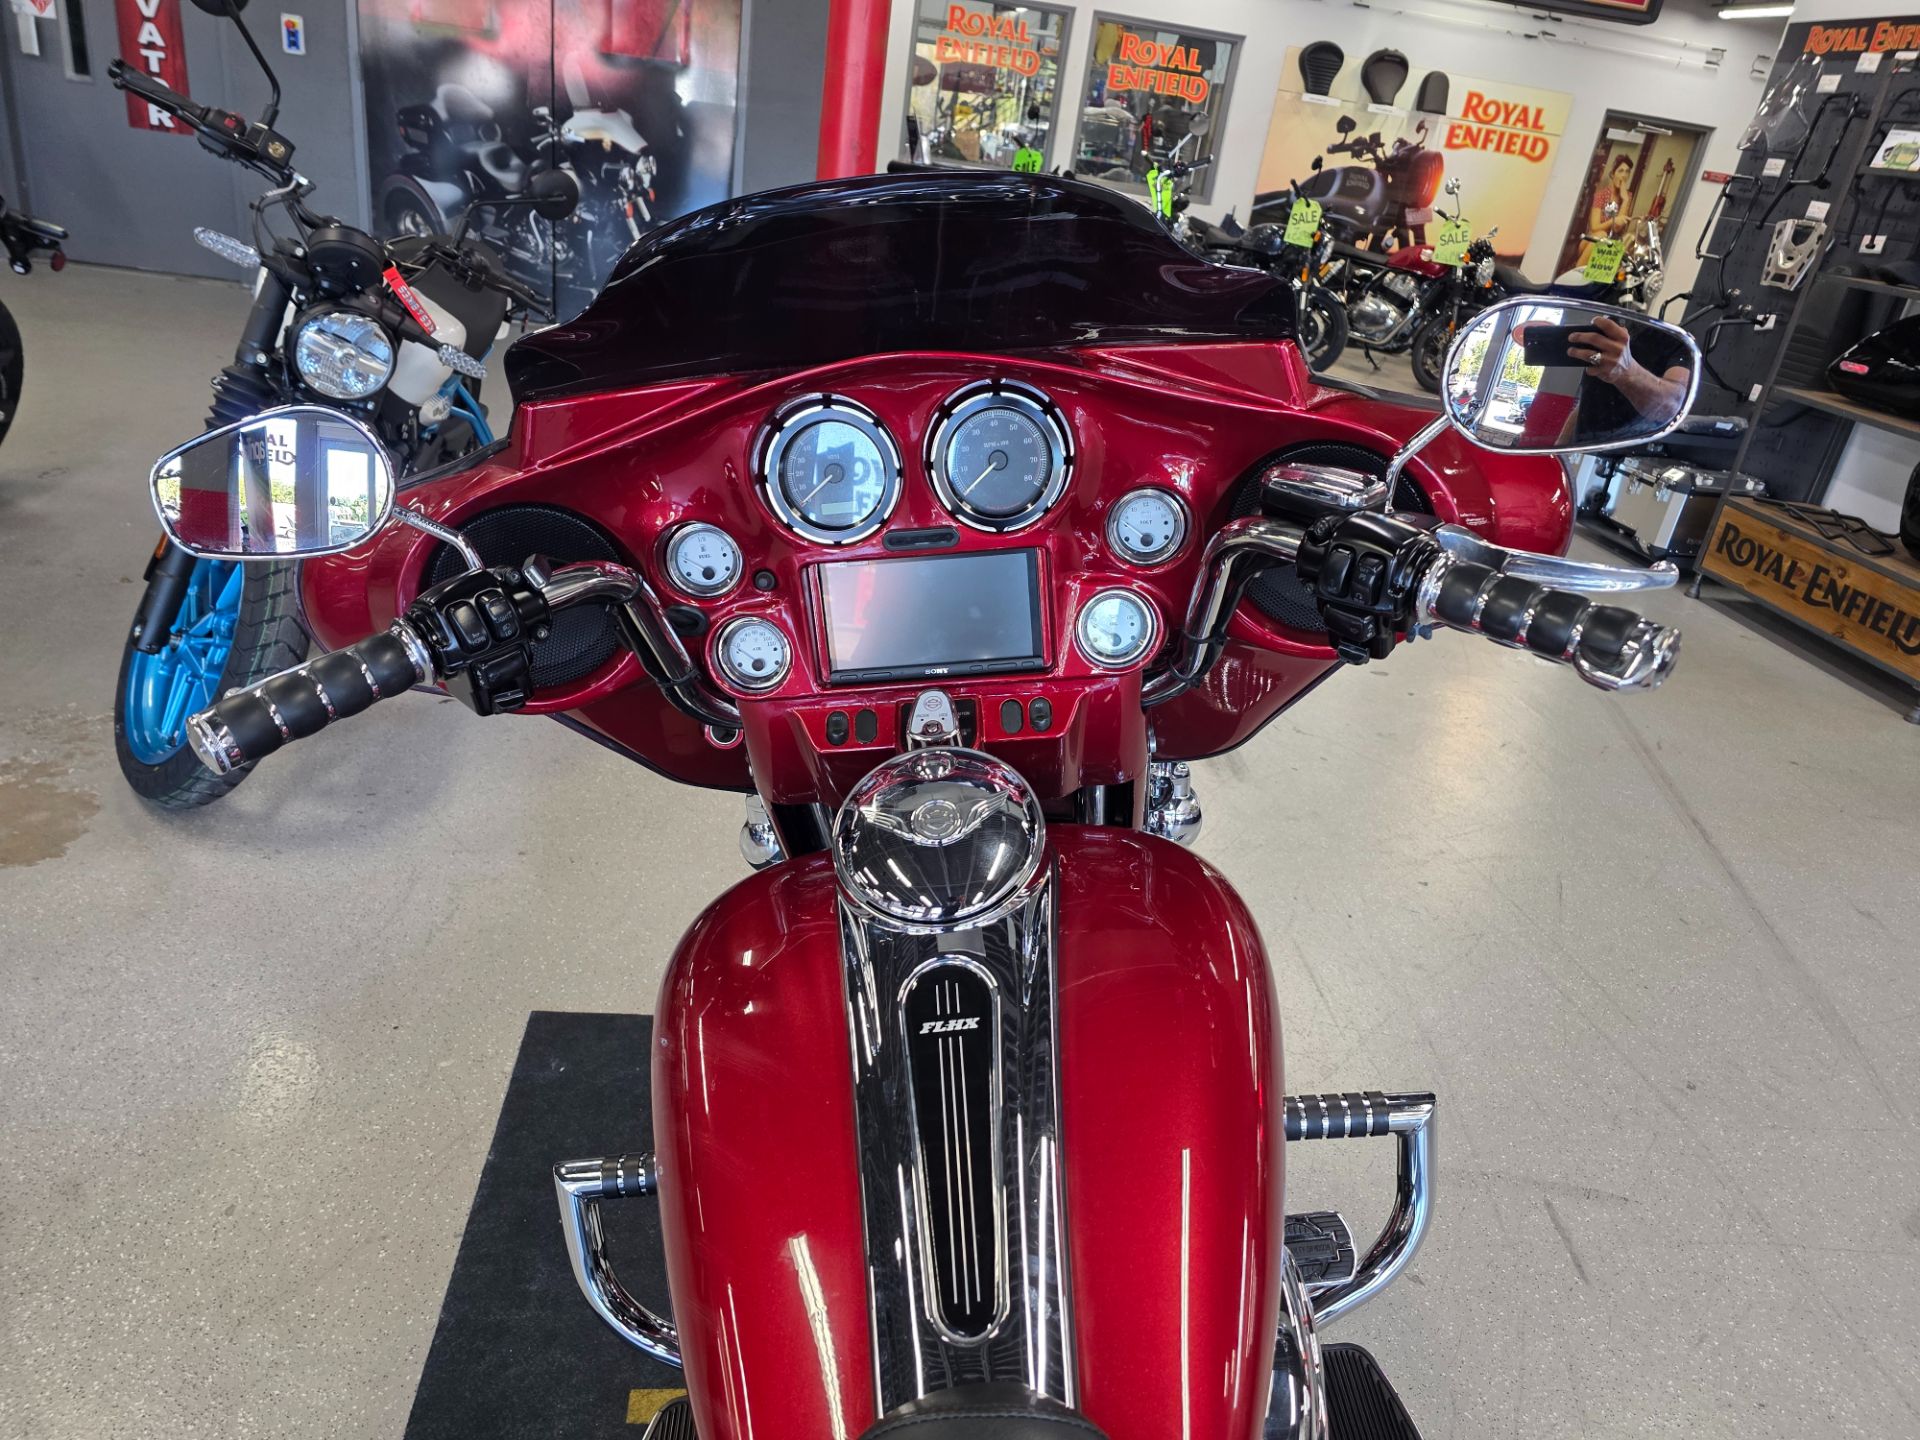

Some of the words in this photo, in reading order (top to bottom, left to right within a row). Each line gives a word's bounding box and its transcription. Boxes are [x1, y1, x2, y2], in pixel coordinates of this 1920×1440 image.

[946, 4, 1032, 43] ROYAL
[1803, 25, 1869, 55] ROYAL
[135, 0, 175, 128] VATR
[935, 35, 1041, 77] ENFIELD
[1120, 32, 1202, 73] ROYAL
[1107, 63, 1209, 104] ENFIELD
[1461, 90, 1546, 131] ROYAL
[1444, 122, 1550, 163] ENFIELD
[1291, 210, 1318, 226] SALE
[1440, 230, 1469, 246] SALE
[1715, 521, 1800, 590] ROYAL
[925, 667, 949, 675] SONY
[919, 1017, 981, 1034] FLHX
